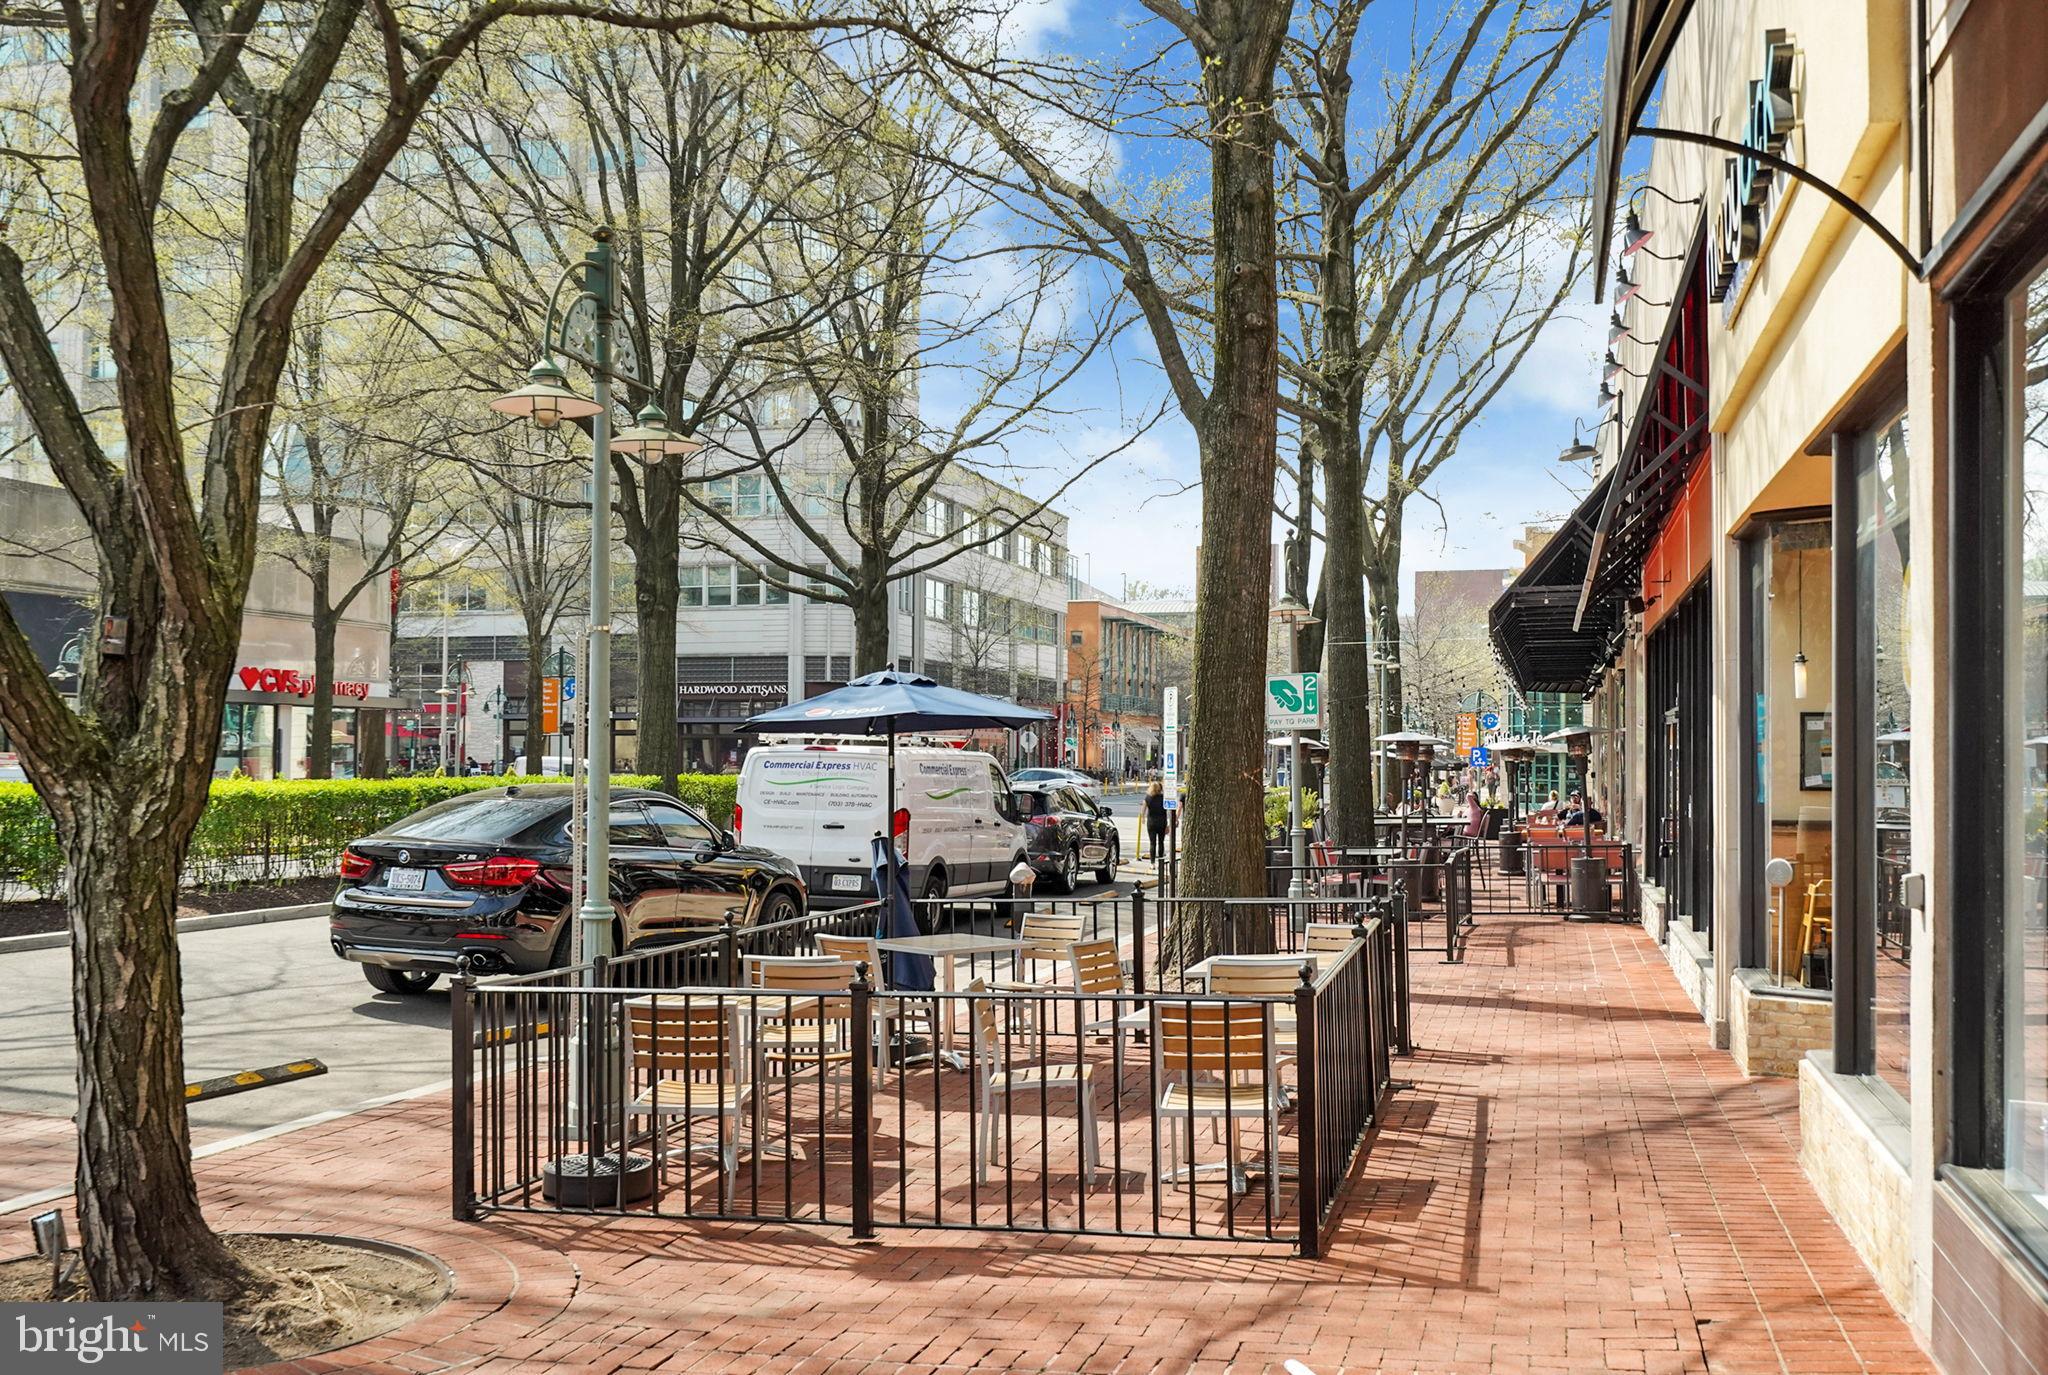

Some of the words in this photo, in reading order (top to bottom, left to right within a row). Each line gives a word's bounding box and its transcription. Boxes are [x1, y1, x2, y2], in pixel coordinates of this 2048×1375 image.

[260, 669, 301, 693] CVS
[300, 674, 369, 700] pmacy
[680, 685, 738, 694] HARDWOOD
[1304, 676, 1316, 691] 2
[831, 705, 888, 716] pepsi
[1297, 717, 1316, 725] PARK
[1472, 749, 1481, 762] P
[764, 760, 815, 770] Commercial
[815, 761, 851, 771] Express
[853, 762, 878, 771] HVAC
[919, 762, 949, 776] Commercial
[949, 764, 967, 777] Express
